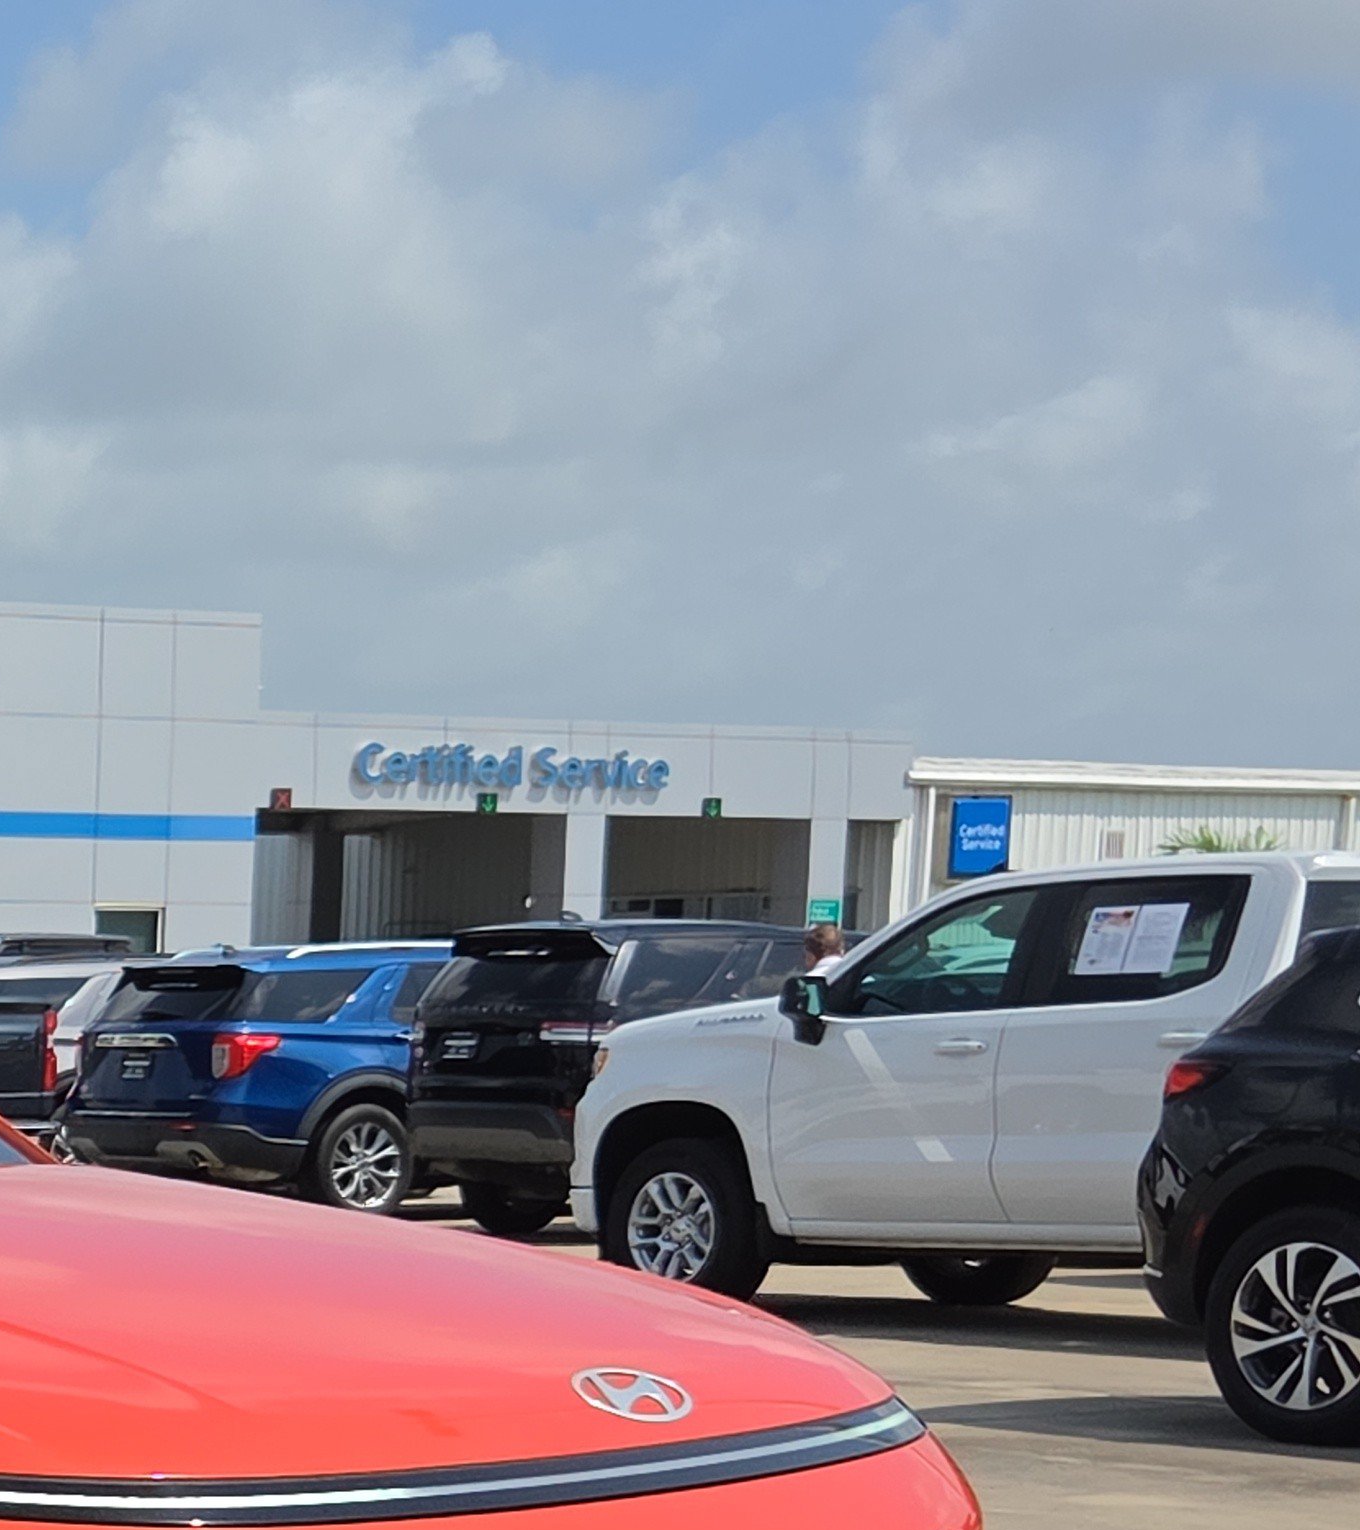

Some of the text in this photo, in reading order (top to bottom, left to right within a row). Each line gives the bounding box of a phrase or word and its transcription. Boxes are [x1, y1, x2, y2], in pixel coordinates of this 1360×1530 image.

[358, 742, 670, 790] Certified Service
[959, 823, 1006, 837] Certified
[961, 838, 1001, 851] Service
